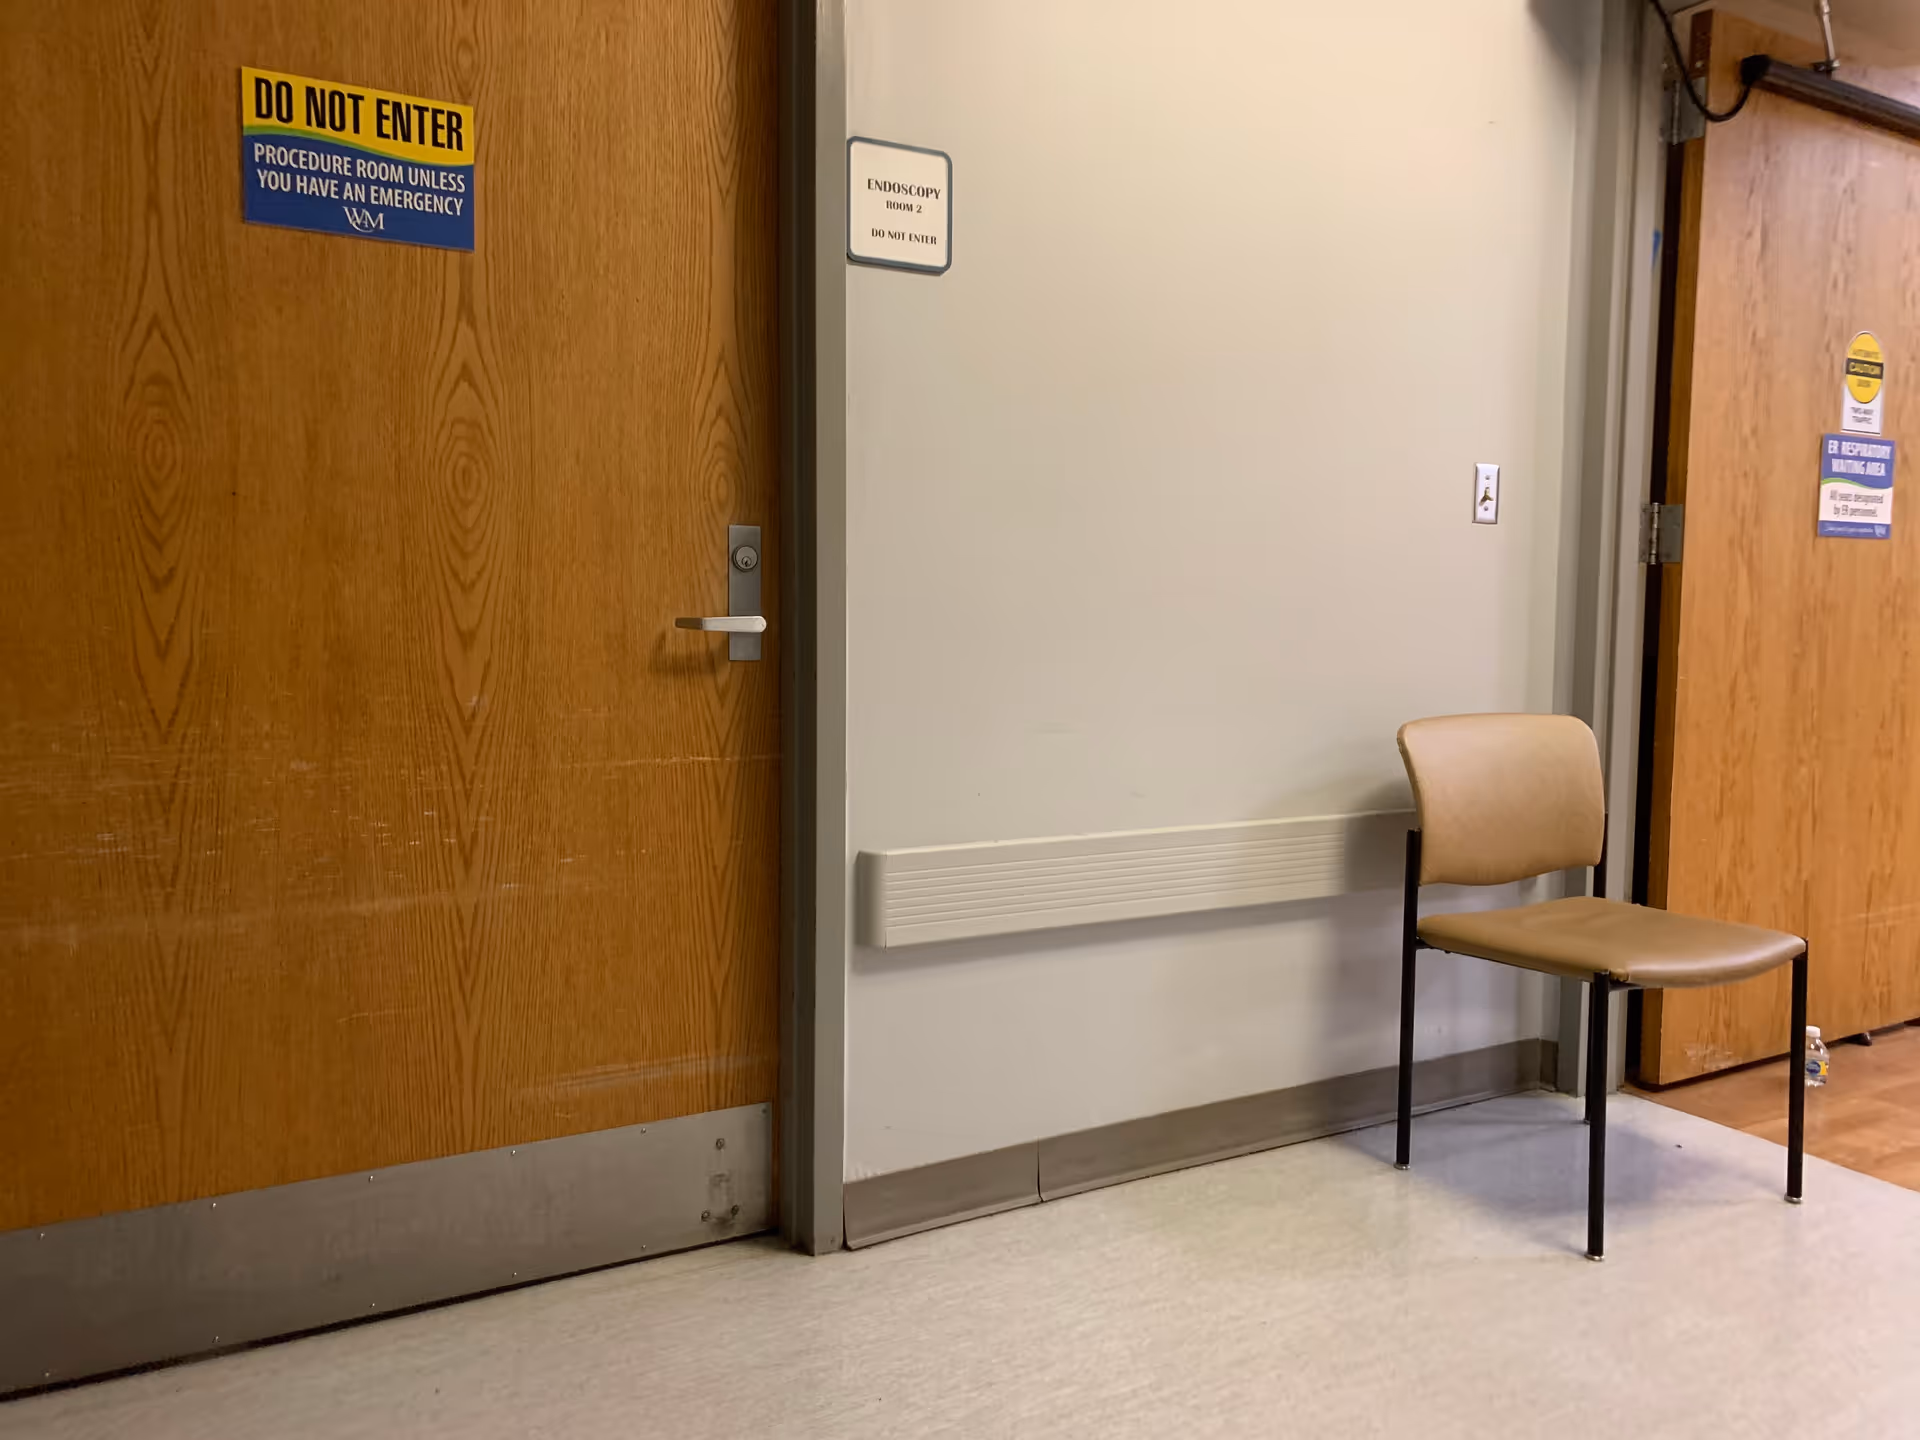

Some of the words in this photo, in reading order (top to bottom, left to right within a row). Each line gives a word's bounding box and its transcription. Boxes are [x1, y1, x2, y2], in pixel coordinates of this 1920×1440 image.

[254, 76, 293, 124] DO
[305, 86, 365, 135] NOT
[376, 97, 463, 151] ENTER
[254, 142, 352, 177] PROCEDURE
[356, 159, 403, 184] ROOM
[408, 167, 466, 193] UNLESS
[257, 169, 292, 192] YOU
[296, 174, 339, 200] HAVE
[343, 182, 365, 203] AN
[370, 186, 464, 216] EMERGENCY
[867, 178, 941, 200] ENDOSCOPY
[886, 200, 913, 213] ROOM
[916, 204, 922, 213] 2
[871, 228, 885, 239] DO
[887, 230, 906, 241] NOT
[908, 233, 937, 246] ENTER
[1849, 362, 1880, 375] CAUTION
[1828, 440, 1839, 454] ER
[1841, 442, 1892, 459] RESPIRATORY
[1832, 459, 1865, 475] WAITING
[1865, 461, 1886, 476] AREA
